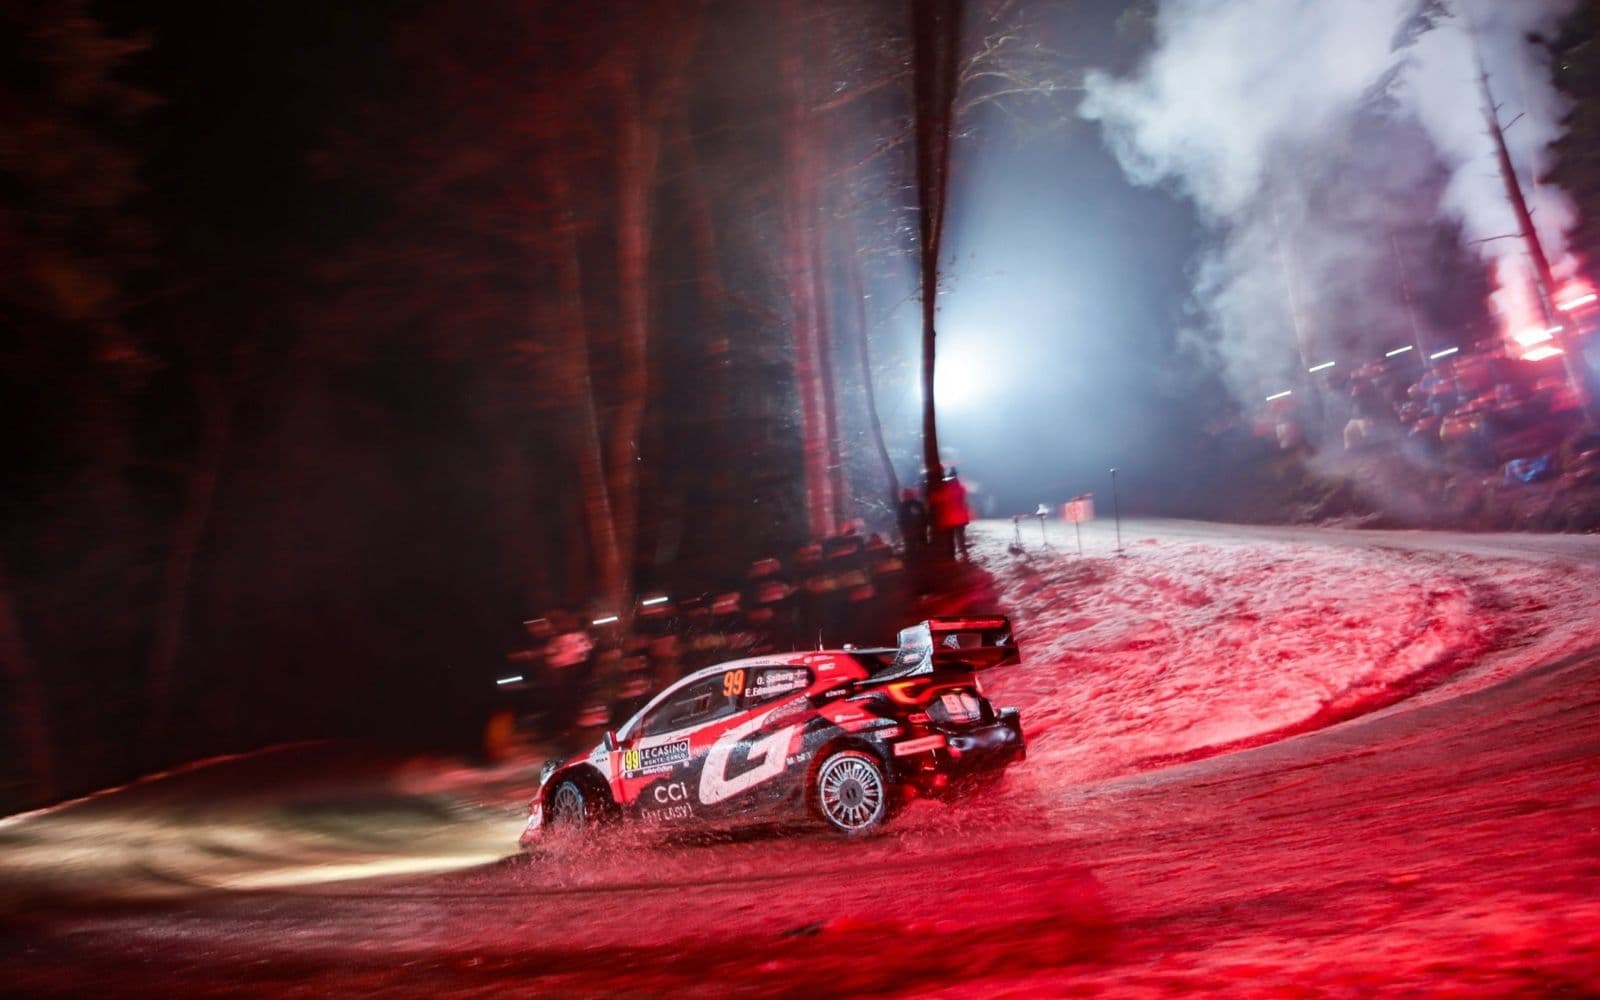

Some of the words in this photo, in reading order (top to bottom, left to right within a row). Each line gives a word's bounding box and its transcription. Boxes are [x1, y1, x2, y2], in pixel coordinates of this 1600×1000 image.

[723, 669, 745, 697] 99
[626, 750, 639, 770] 99
[641, 749, 650, 760] LE
[651, 741, 687, 758] CASINO
